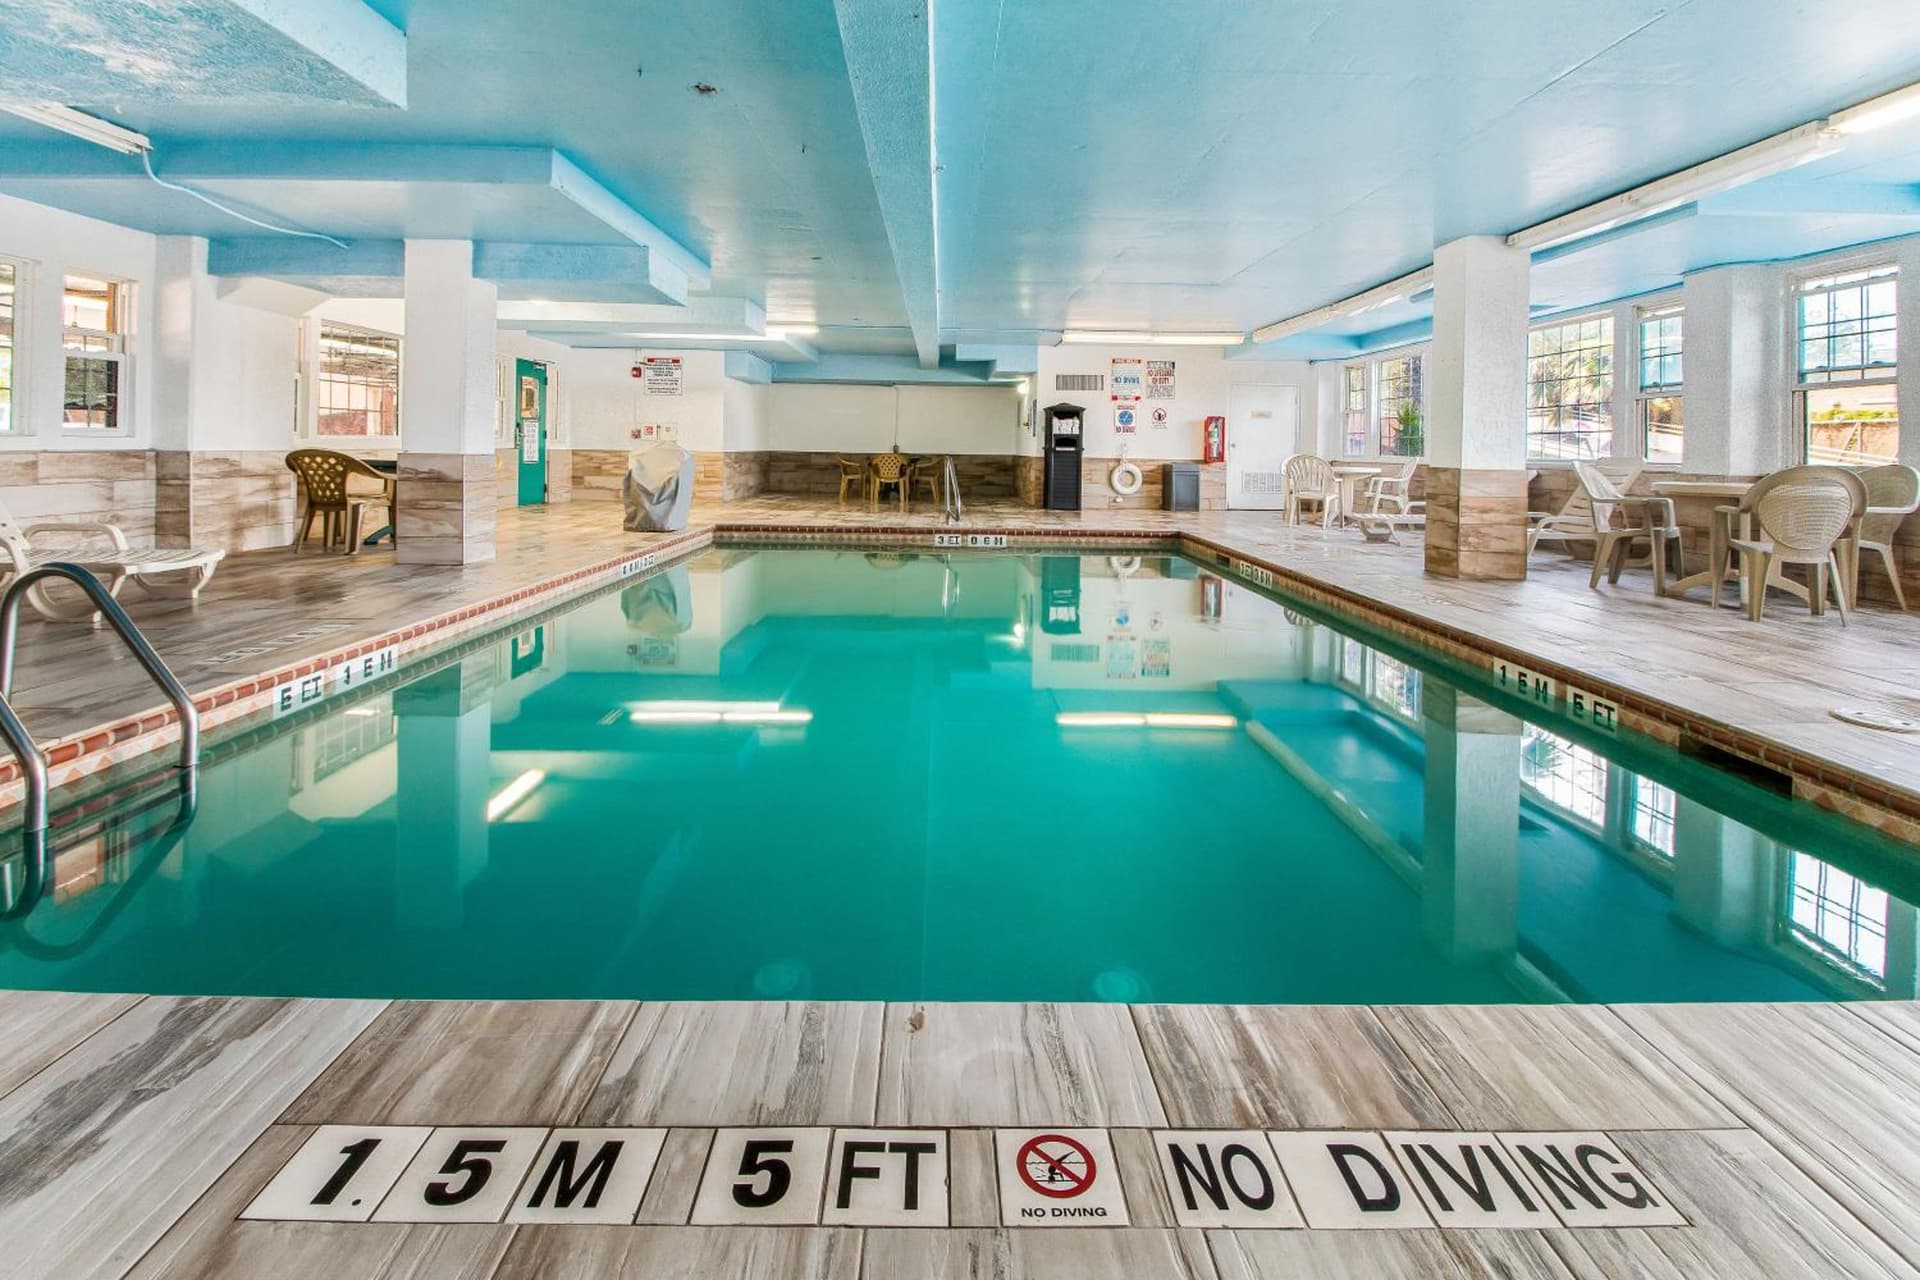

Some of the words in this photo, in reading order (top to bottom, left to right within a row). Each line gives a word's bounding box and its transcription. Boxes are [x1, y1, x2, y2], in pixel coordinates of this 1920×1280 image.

[731, 1140, 795, 1208] 5
[835, 1141, 937, 1210] FT
[1168, 1143, 1276, 1212] NO
[1326, 1143, 1660, 1211] DIVING
[1021, 1207, 1046, 1217] NO
[1051, 1207, 1107, 1217] DIVING
